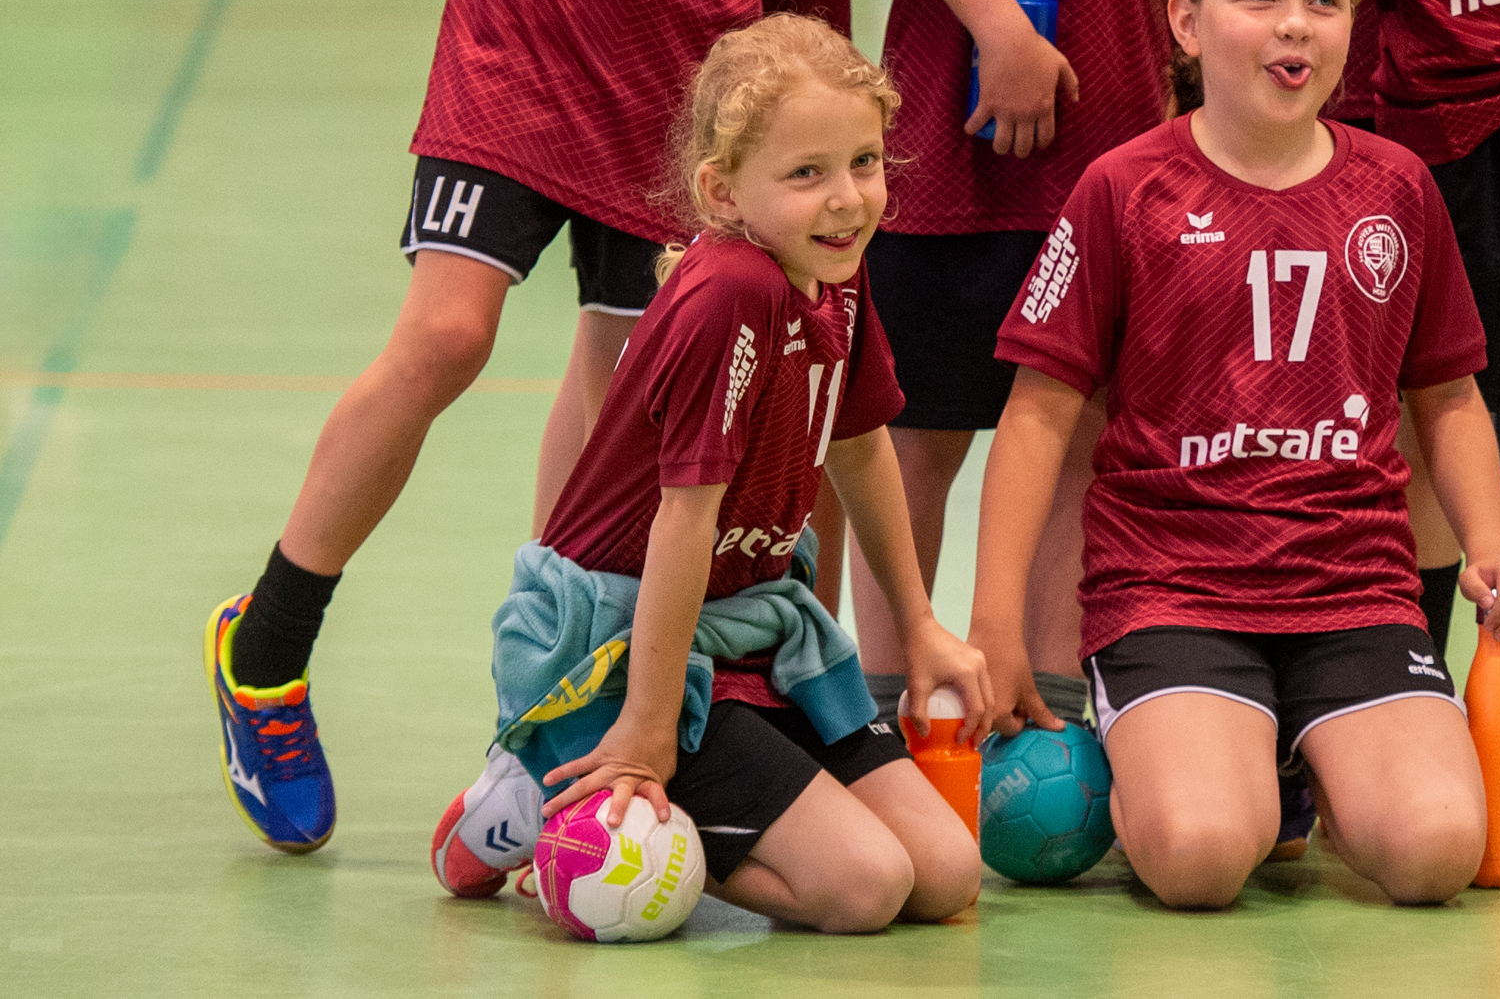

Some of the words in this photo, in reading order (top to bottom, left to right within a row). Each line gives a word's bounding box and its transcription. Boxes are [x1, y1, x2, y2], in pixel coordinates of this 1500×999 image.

[421, 175, 485, 238] LH
[1180, 229, 1226, 245] erima
[1037, 239, 1077, 323] sport
[1246, 249, 1328, 362] 17
[1179, 420, 1359, 468] netsafe
[641, 833, 688, 921] erima
